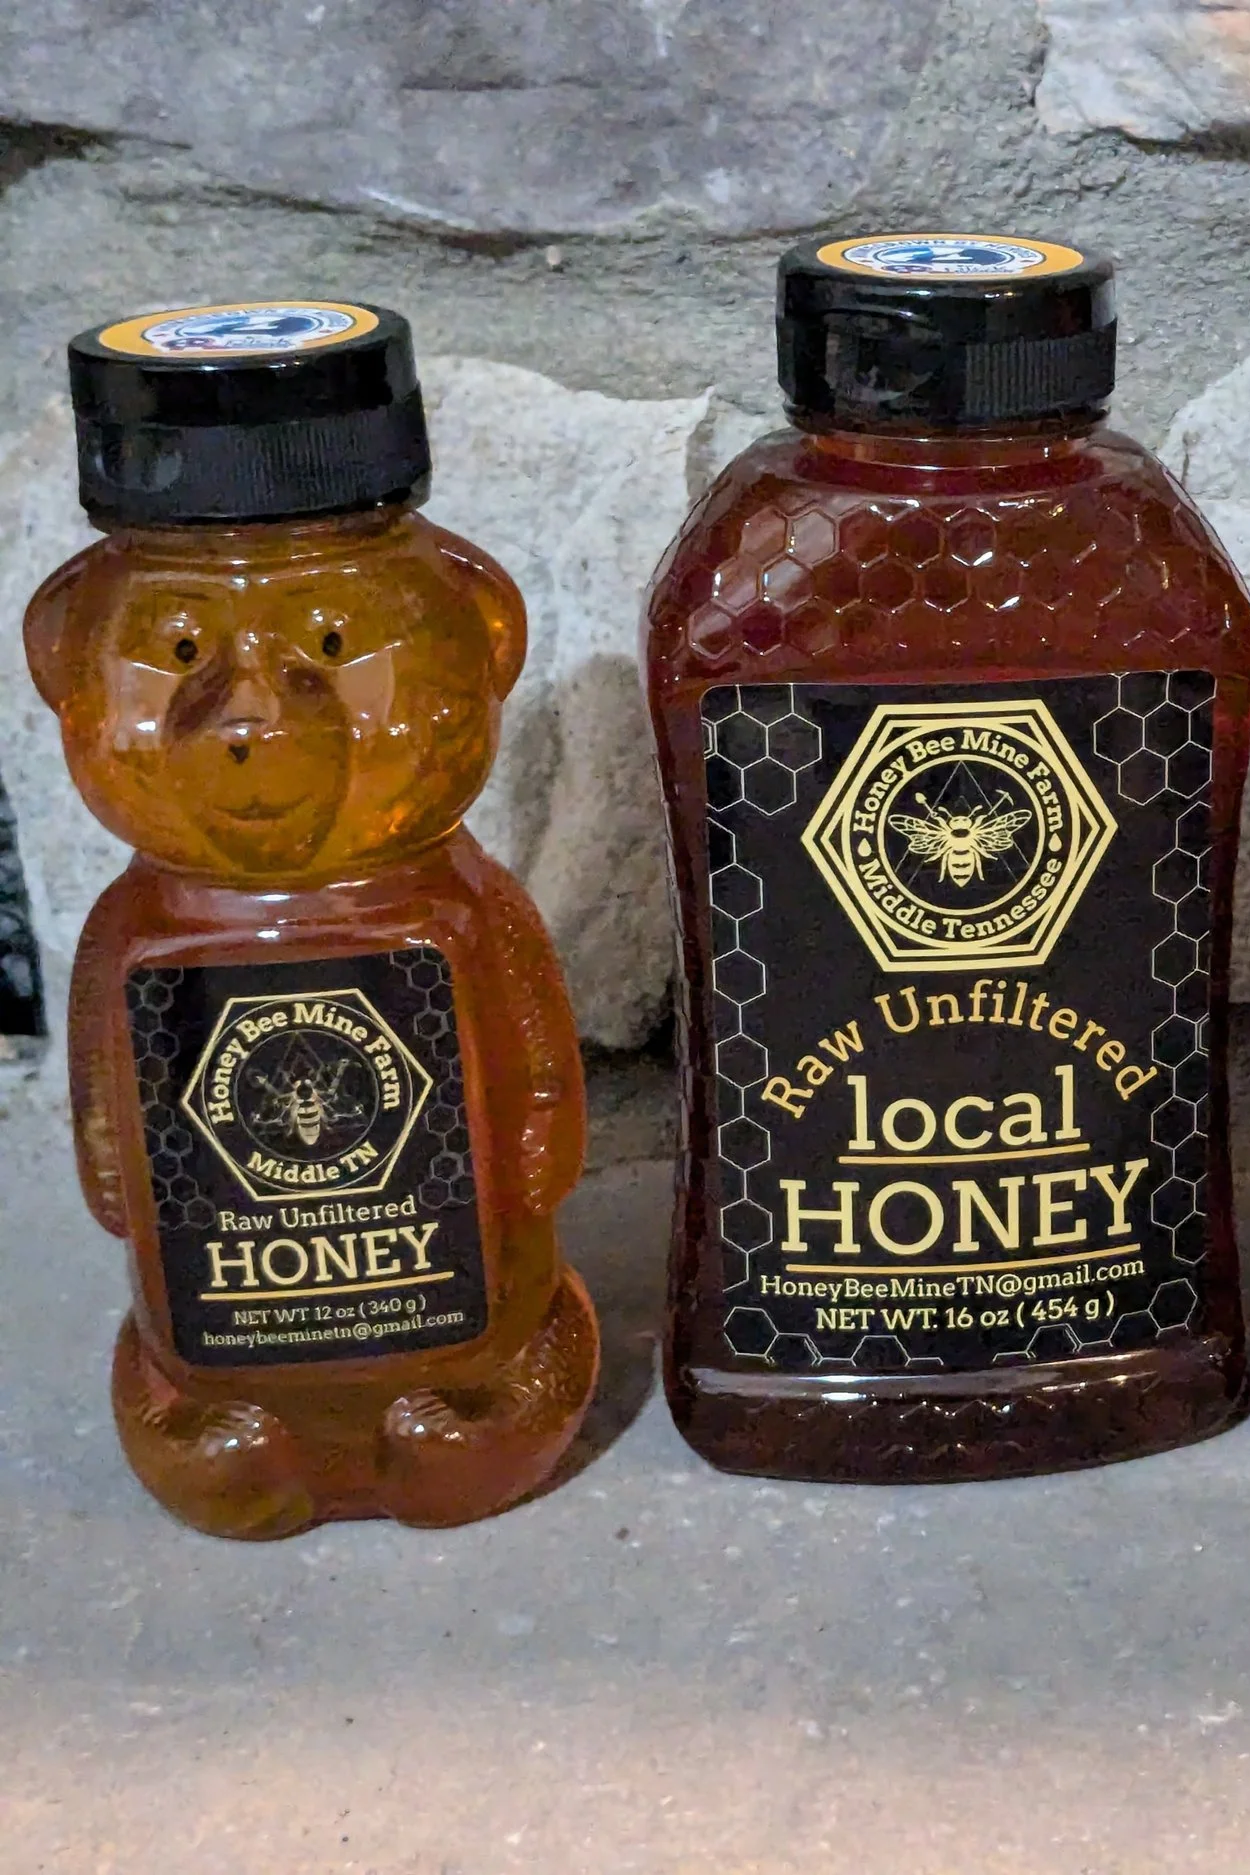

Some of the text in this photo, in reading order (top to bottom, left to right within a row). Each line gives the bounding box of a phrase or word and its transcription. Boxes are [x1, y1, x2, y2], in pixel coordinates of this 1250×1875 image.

[853, 728, 1065, 834] Honey Bee Mine Farm
[858, 858, 1062, 939] Middle Tennessee
[207, 1002, 401, 1124] Honey Bee Mine Farm
[761, 978, 1158, 1119] Raw Unfiltered
[846, 1064, 1082, 1152] local
[247, 1140, 379, 1184] Middle TN
[217, 1194, 417, 1232] Raw Unfiltered
[779, 1158, 1149, 1256] HONEY
[205, 1222, 440, 1288] HONEY
[760, 1258, 1145, 1302] HoneyBeeMineTN@gmail.com
[203, 1311, 464, 1348] honeybeeminetn@gmail.com
[233, 1309, 271, 1326] NET
[315, 1305, 331, 1321] 12
[335, 1306, 356, 1319] oz
[815, 1307, 875, 1330] NET
[881, 1308, 940, 1331] WT.
[946, 1307, 973, 1329] 16
[979, 1309, 1009, 1327] oz
